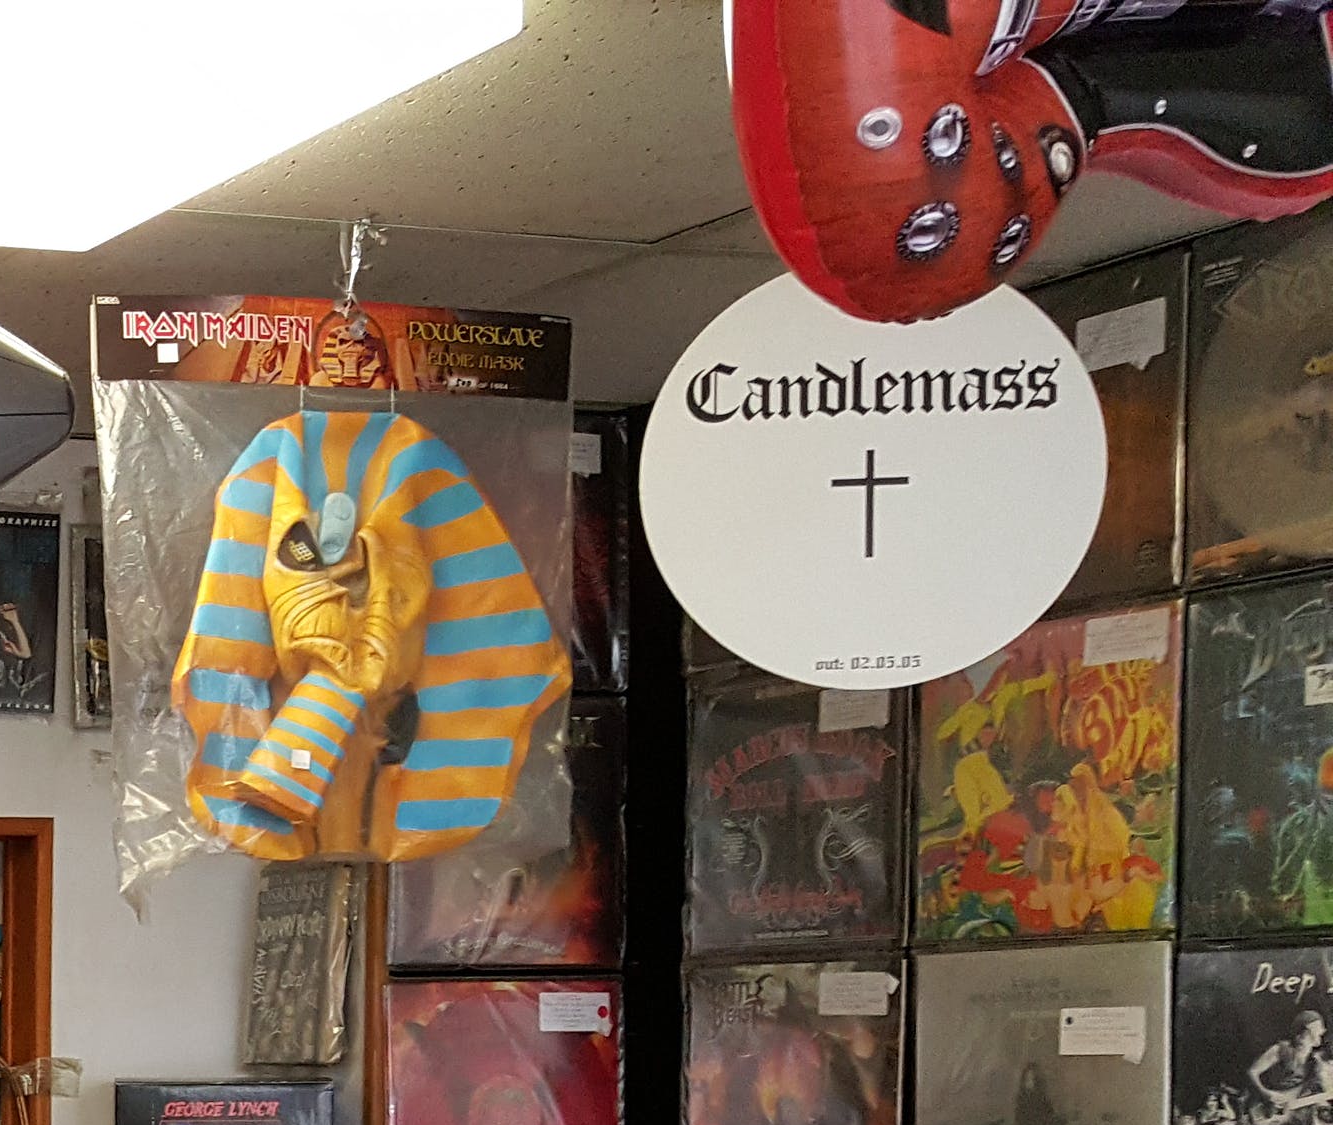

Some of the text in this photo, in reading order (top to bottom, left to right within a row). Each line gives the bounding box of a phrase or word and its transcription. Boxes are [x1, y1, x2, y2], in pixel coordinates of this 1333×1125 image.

[122, 311, 313, 354] IRON MAIDEN
[408, 321, 545, 348] POWERSLAVE
[686, 357, 1061, 423] Candlemass
[1254, 962, 1316, 1002] Deep
[164, 1101, 279, 1117] GEORGE LYNCH
